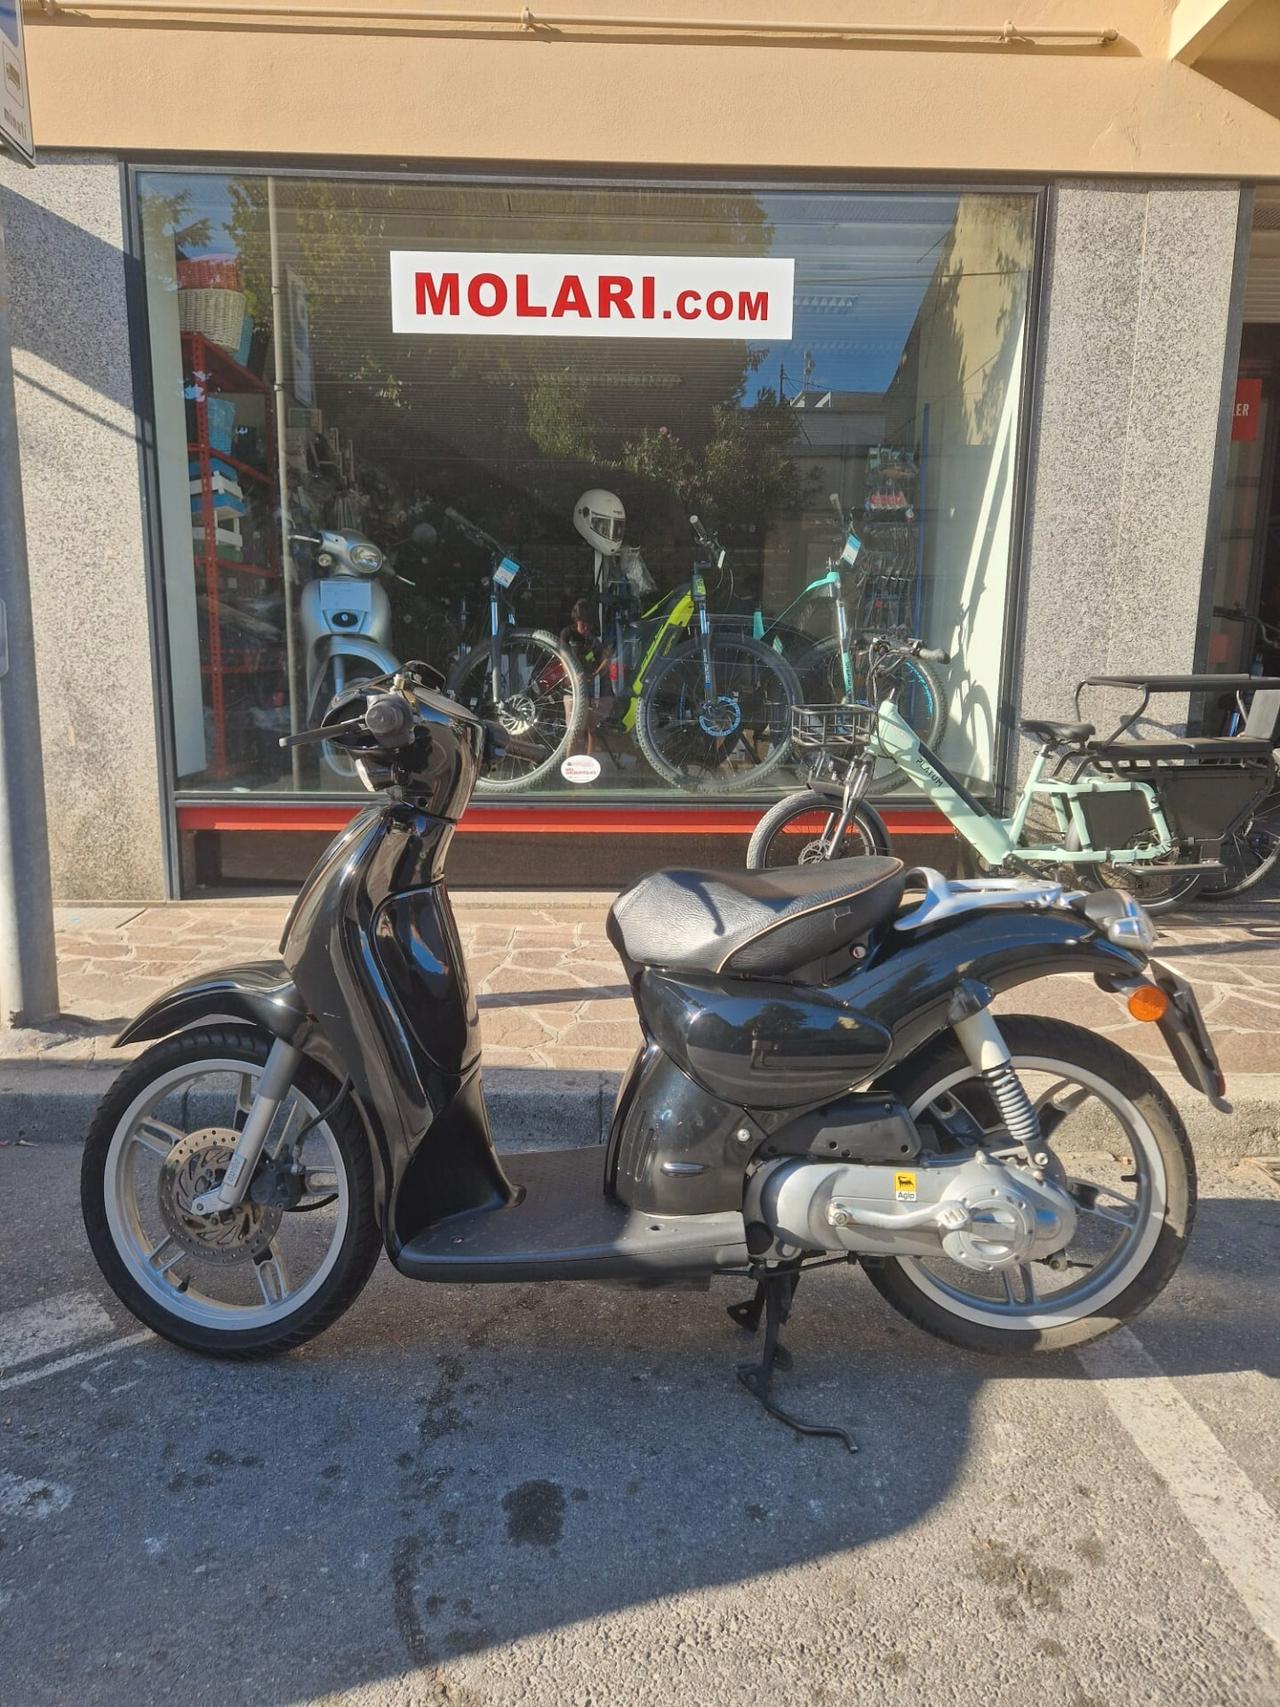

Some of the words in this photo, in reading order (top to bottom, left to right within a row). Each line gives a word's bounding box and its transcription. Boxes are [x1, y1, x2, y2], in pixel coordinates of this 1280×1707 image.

[415, 272, 769, 321] MOLARI.COM
[1234, 403, 1250, 417] ER
[916, 759, 944, 787] PLATUM
